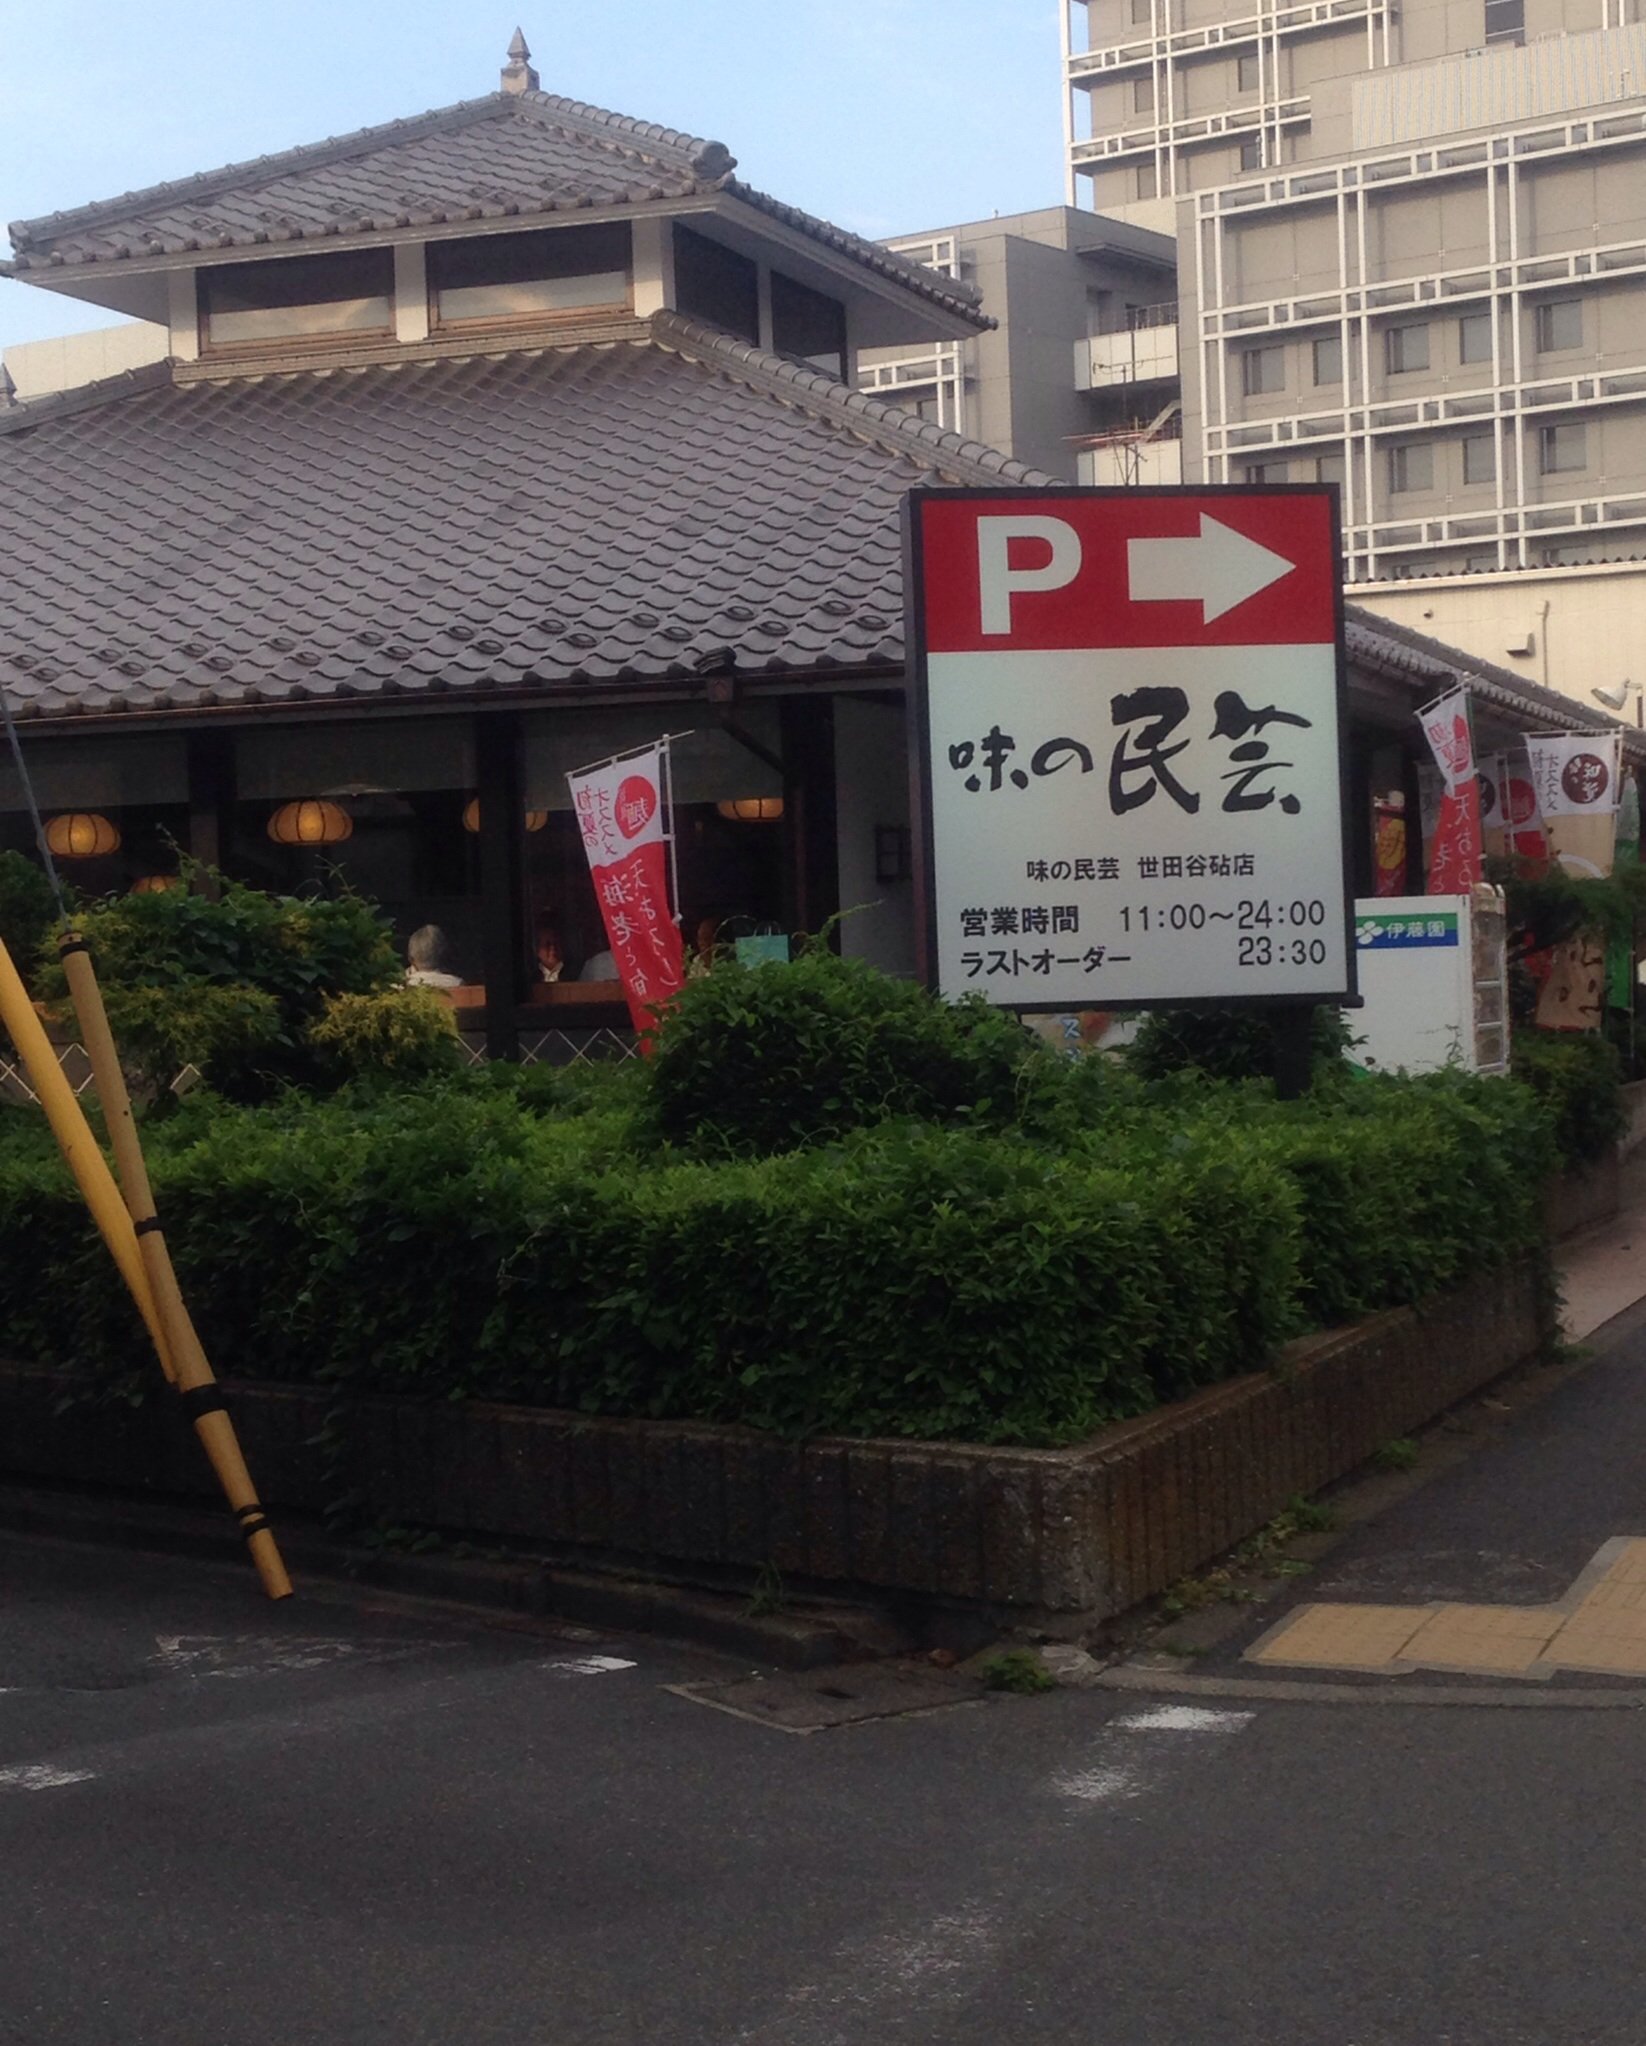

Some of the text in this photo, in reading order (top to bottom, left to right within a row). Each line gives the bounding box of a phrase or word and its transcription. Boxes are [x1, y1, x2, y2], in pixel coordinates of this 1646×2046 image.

[976, 514, 1083, 635] P
[948, 686, 1313, 815] 味の民芸
[1026, 853, 1255, 882] 味の民芸 世田谷砧店
[960, 904, 1080, 937] 営業時間
[960, 935, 1326, 978] ラストオーダー 23:30
